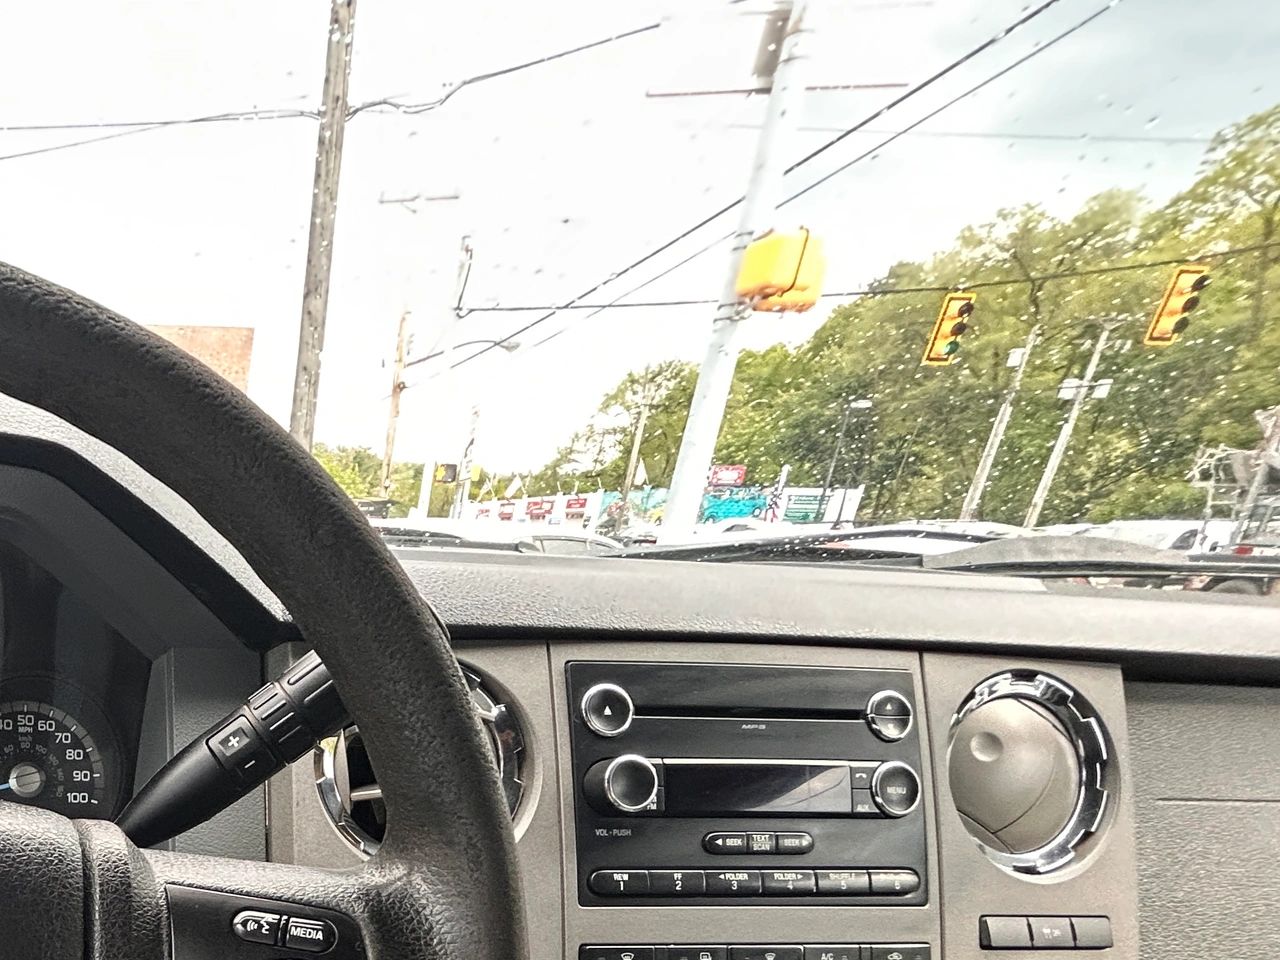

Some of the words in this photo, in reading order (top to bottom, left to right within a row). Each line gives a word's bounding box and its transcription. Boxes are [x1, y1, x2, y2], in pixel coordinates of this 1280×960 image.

[17, 714, 34, 726] 50
[18, 726, 33, 734] MPH
[37, 720, 55, 731] 60
[54, 733, 71, 743] 70
[65, 749, 83, 760] 80
[72, 770, 90, 782] 90
[886, 786, 906, 795] MENU
[66, 792, 89, 804] 100
[856, 804, 870, 812] AUX
[595, 828, 609, 836] VOL
[612, 828, 632, 836] PUSH
[726, 838, 742, 846] SEEK
[752, 834, 770, 842] TEXT
[784, 838, 800, 846] SEEK
[753, 843, 770, 851] SCAN
[613, 873, 629, 881] REW
[673, 873, 683, 881] FF
[675, 881, 682, 891] 2
[731, 881, 738, 890] 3
[786, 881, 794, 890] 4
[841, 880, 847, 890] 5
[290, 926, 324, 941] MEDIA
[821, 953, 834, 960] A/C
